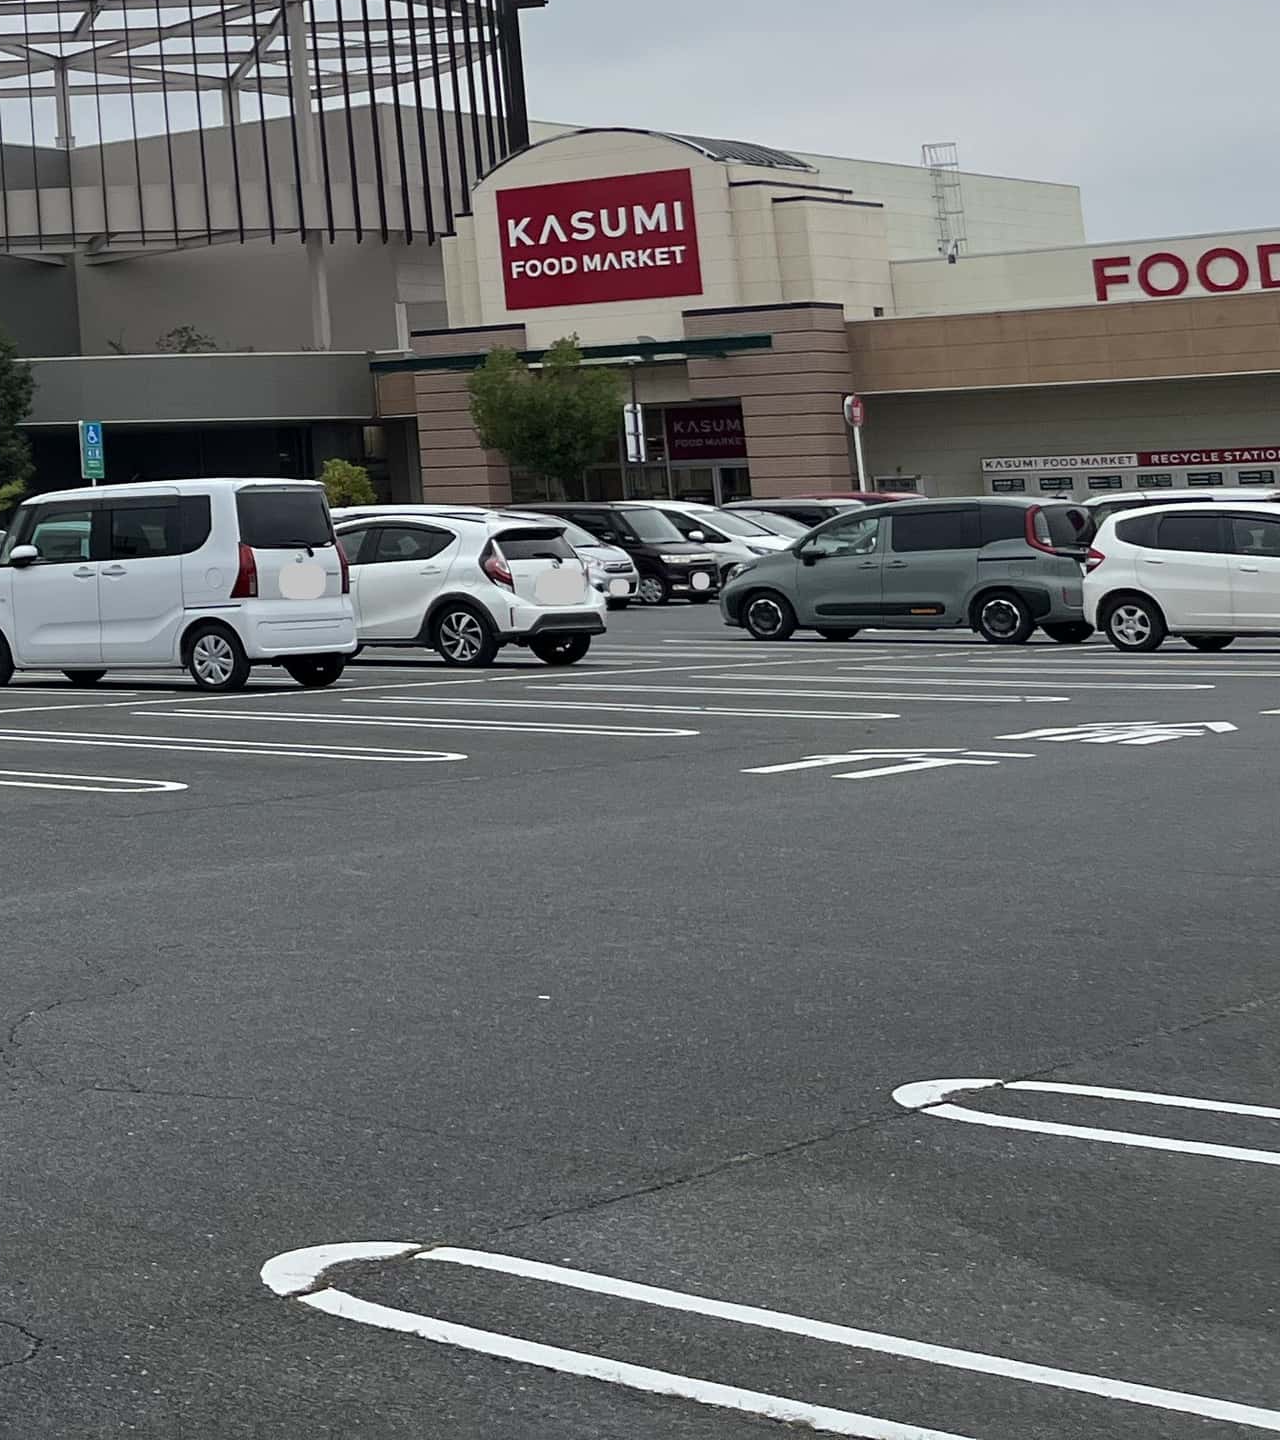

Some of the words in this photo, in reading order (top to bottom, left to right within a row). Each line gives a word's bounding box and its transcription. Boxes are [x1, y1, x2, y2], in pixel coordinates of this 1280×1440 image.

[507, 201, 685, 248] KASUMI
[511, 257, 578, 279] FOOD
[583, 246, 687, 272] MARKET
[672, 418, 743, 433] KASUM
[705, 436, 744, 447] MARKE
[985, 459, 1038, 469] KASUMI
[1043, 457, 1078, 467] FOOD
[1081, 455, 1134, 465] MARKET
[1150, 452, 1220, 464] RECYCLE
[1223, 449, 1280, 461] STATIO
